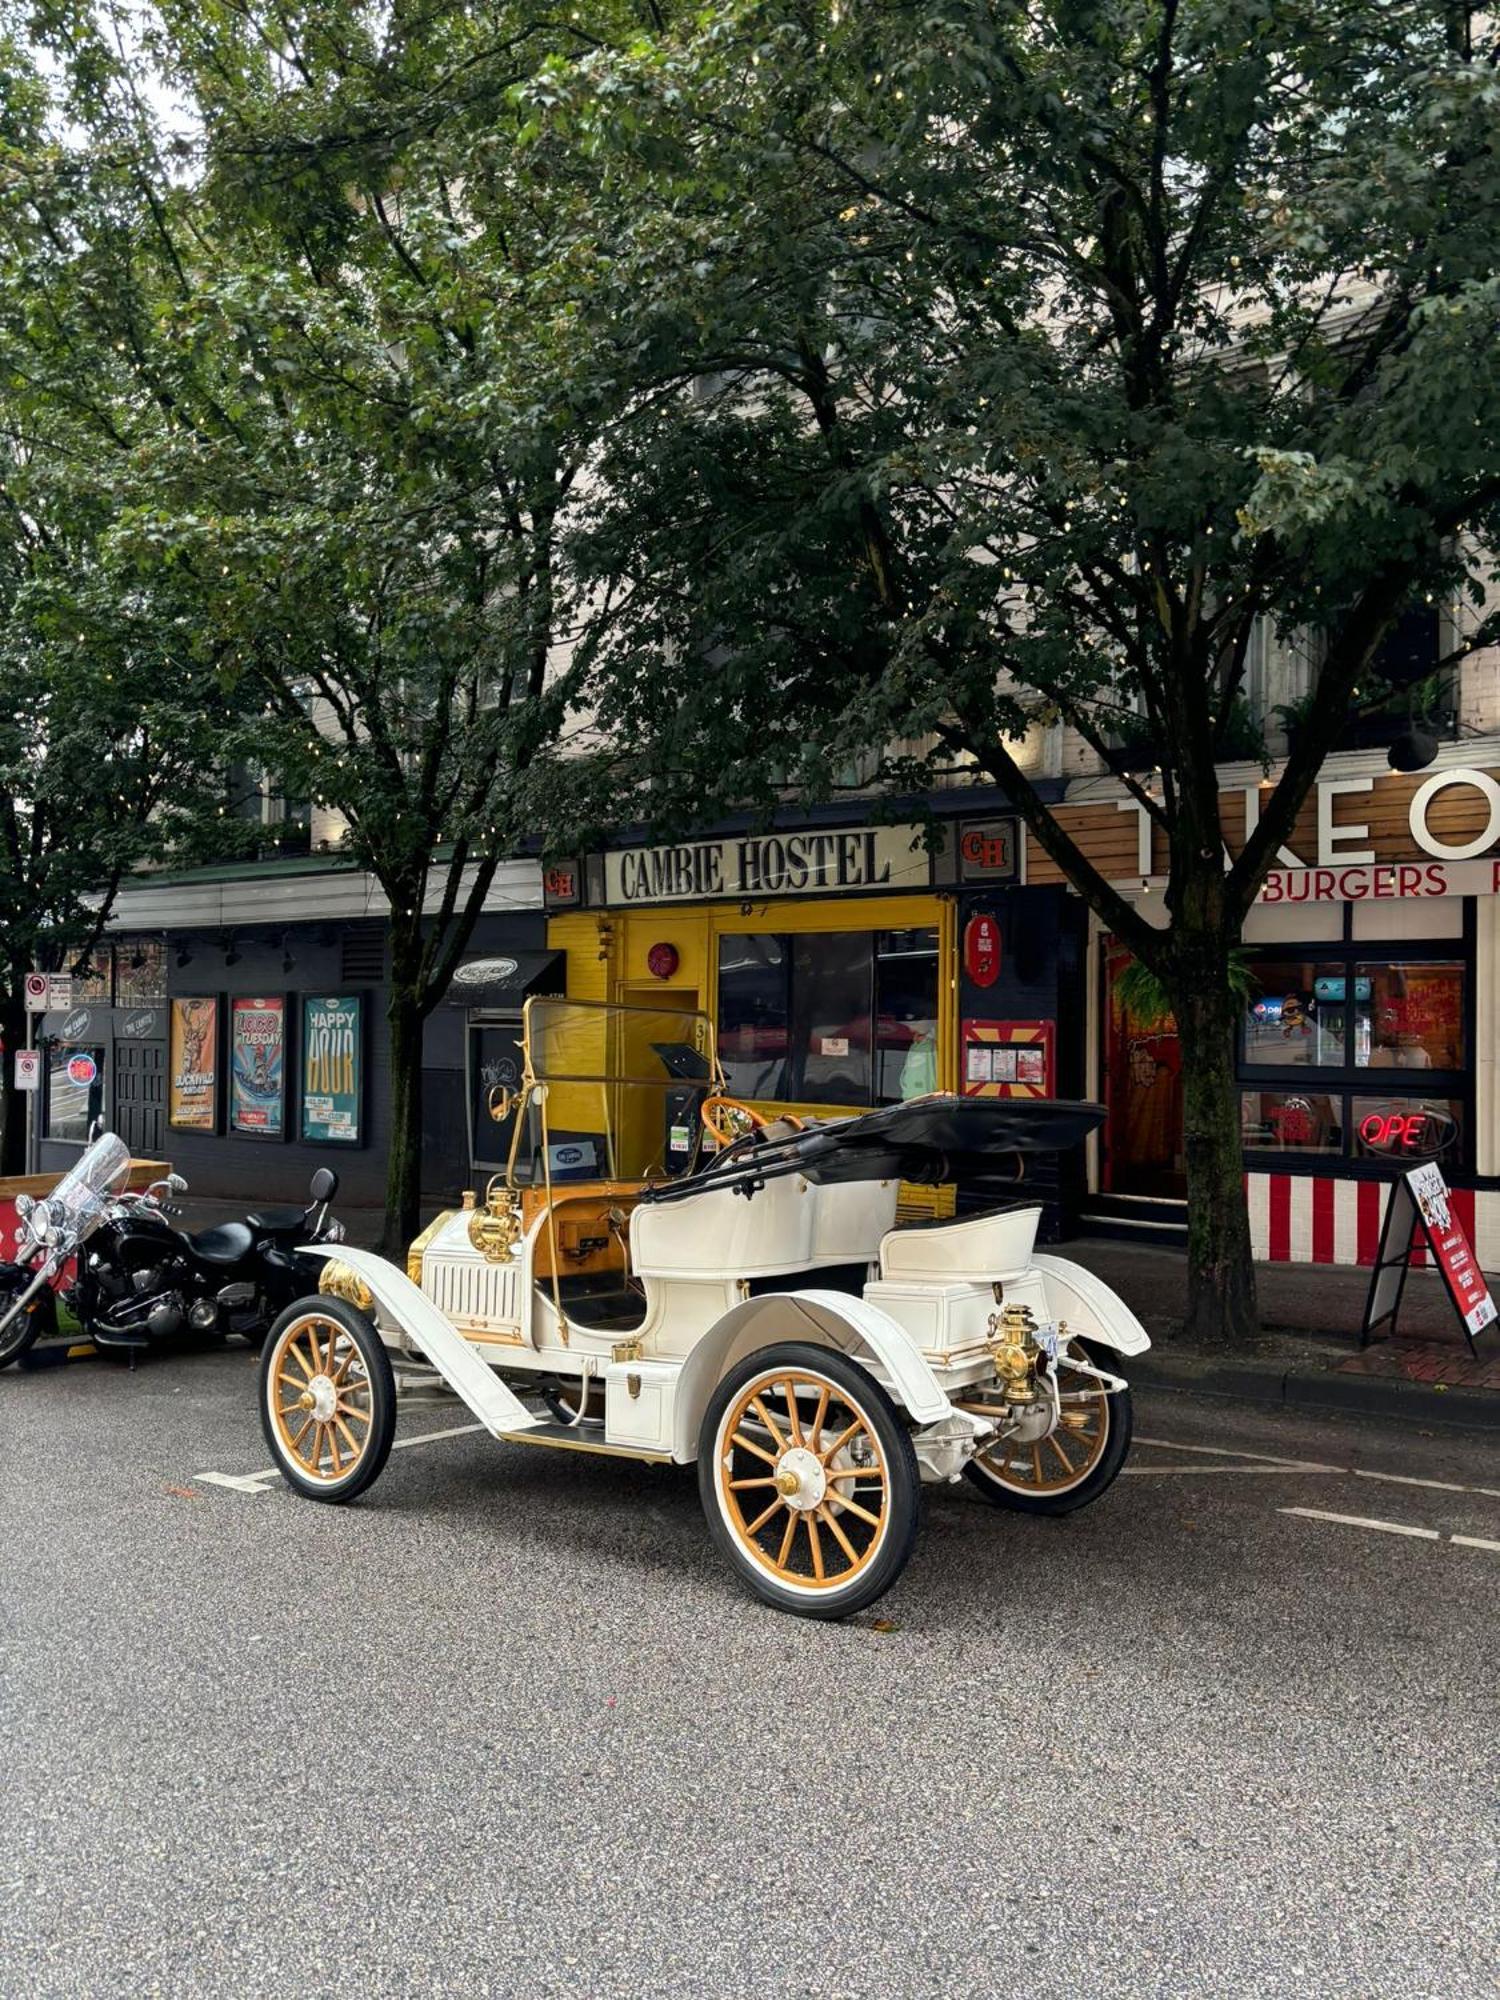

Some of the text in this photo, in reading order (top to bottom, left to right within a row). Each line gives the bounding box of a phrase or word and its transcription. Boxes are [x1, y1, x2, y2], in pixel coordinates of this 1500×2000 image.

[961, 831, 1006, 868] CH
[1117, 777, 1375, 876] TKE
[620, 831, 891, 900] CAMBIE HOSTEL
[1262, 864, 1448, 902] BURGERS
[310, 1012, 355, 1028] HAPPY
[308, 1028, 354, 1094] HOUR
